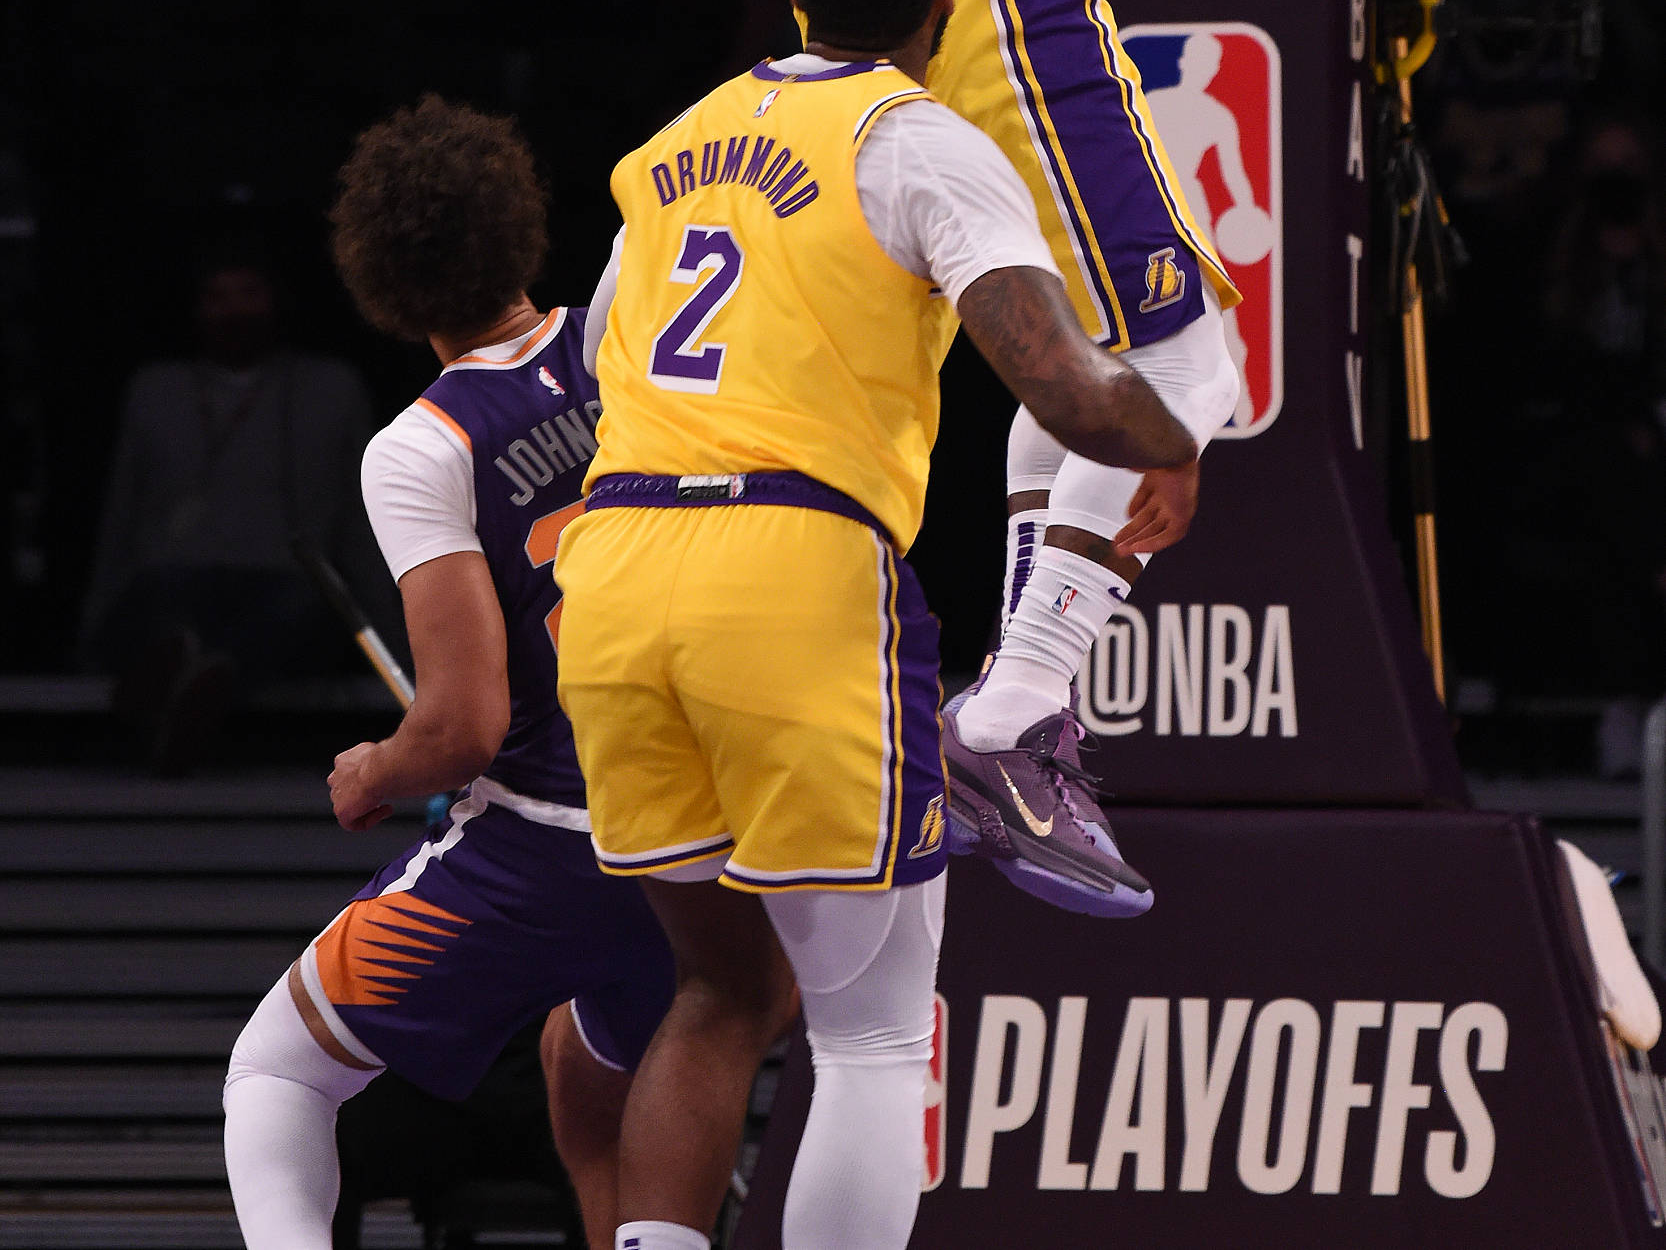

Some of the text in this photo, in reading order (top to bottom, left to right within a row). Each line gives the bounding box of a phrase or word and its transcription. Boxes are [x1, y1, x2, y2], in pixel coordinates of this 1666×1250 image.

[651, 135, 820, 219] DRUMMOND
[646, 224, 745, 395] 2
[1077, 603, 1299, 738] @NBA
[960, 994, 1509, 1199] PLAYOFFS
